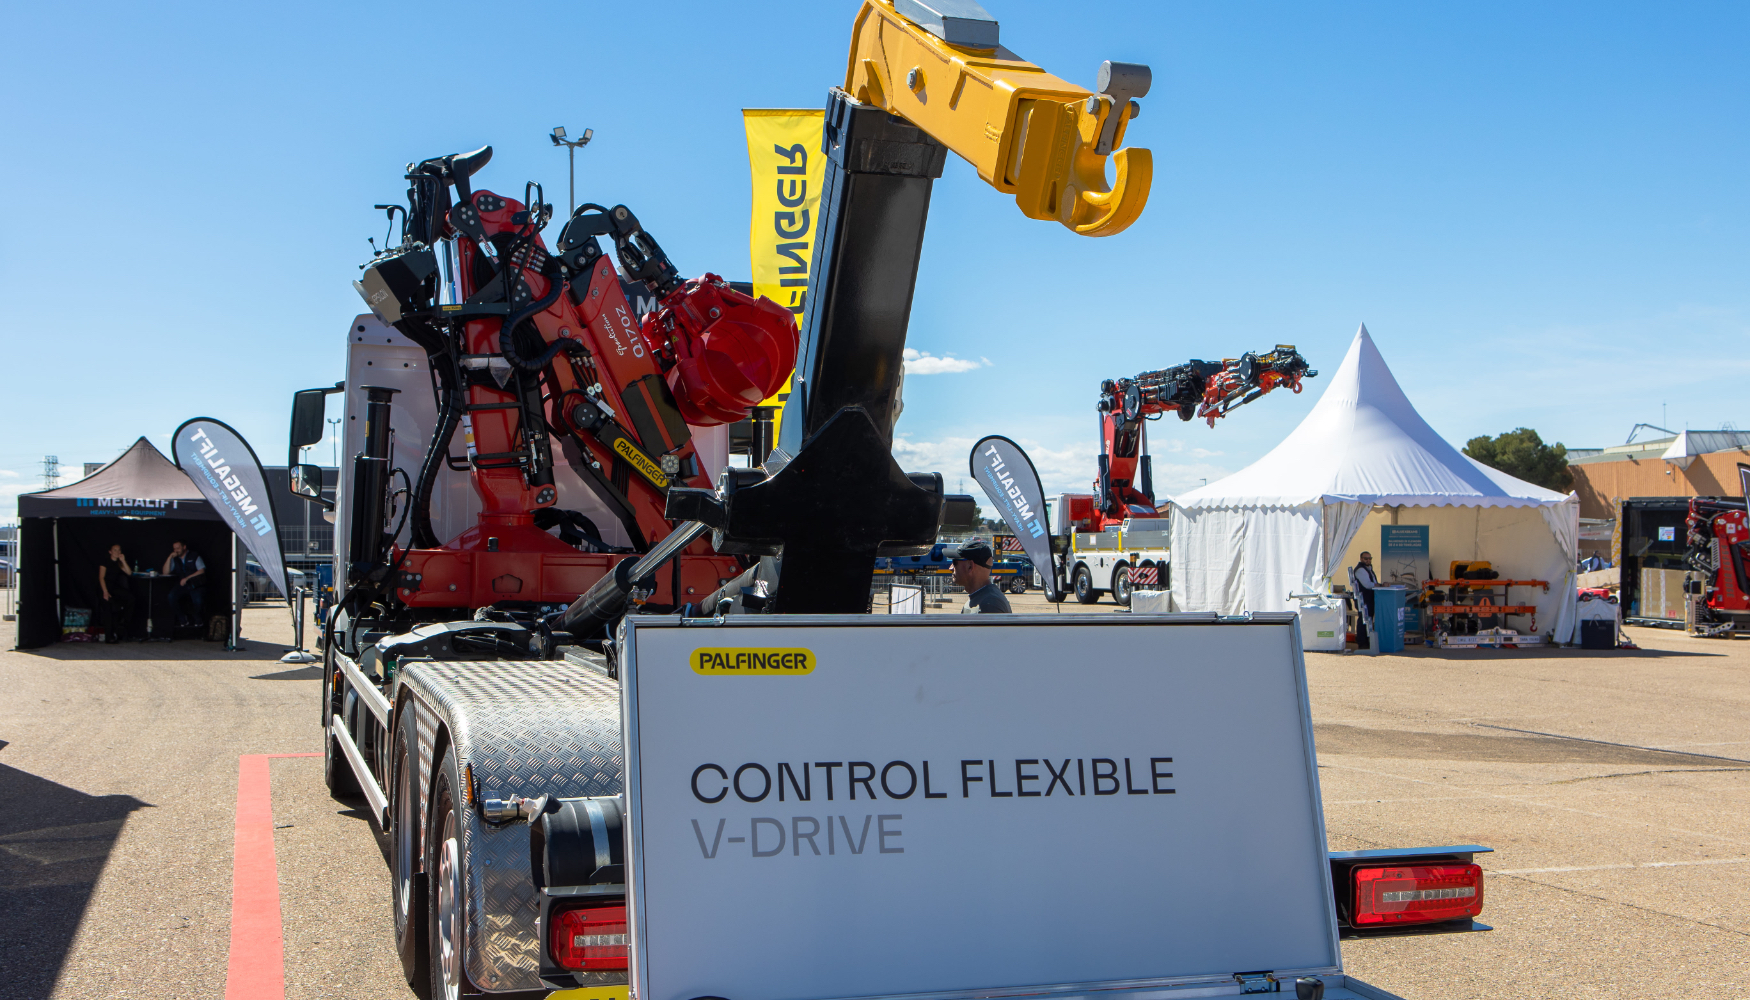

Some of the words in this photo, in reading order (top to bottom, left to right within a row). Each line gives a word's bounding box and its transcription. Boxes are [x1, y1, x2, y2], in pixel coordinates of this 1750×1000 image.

[615, 304, 645, 358] Q170Z
[616, 440, 666, 485] PALFINGER
[700, 653, 806, 669] PALFINGER
[691, 761, 947, 803] CONTROL
[961, 758, 1175, 797] FLEXIBLE
[692, 815, 904, 858] V-DRIVE
